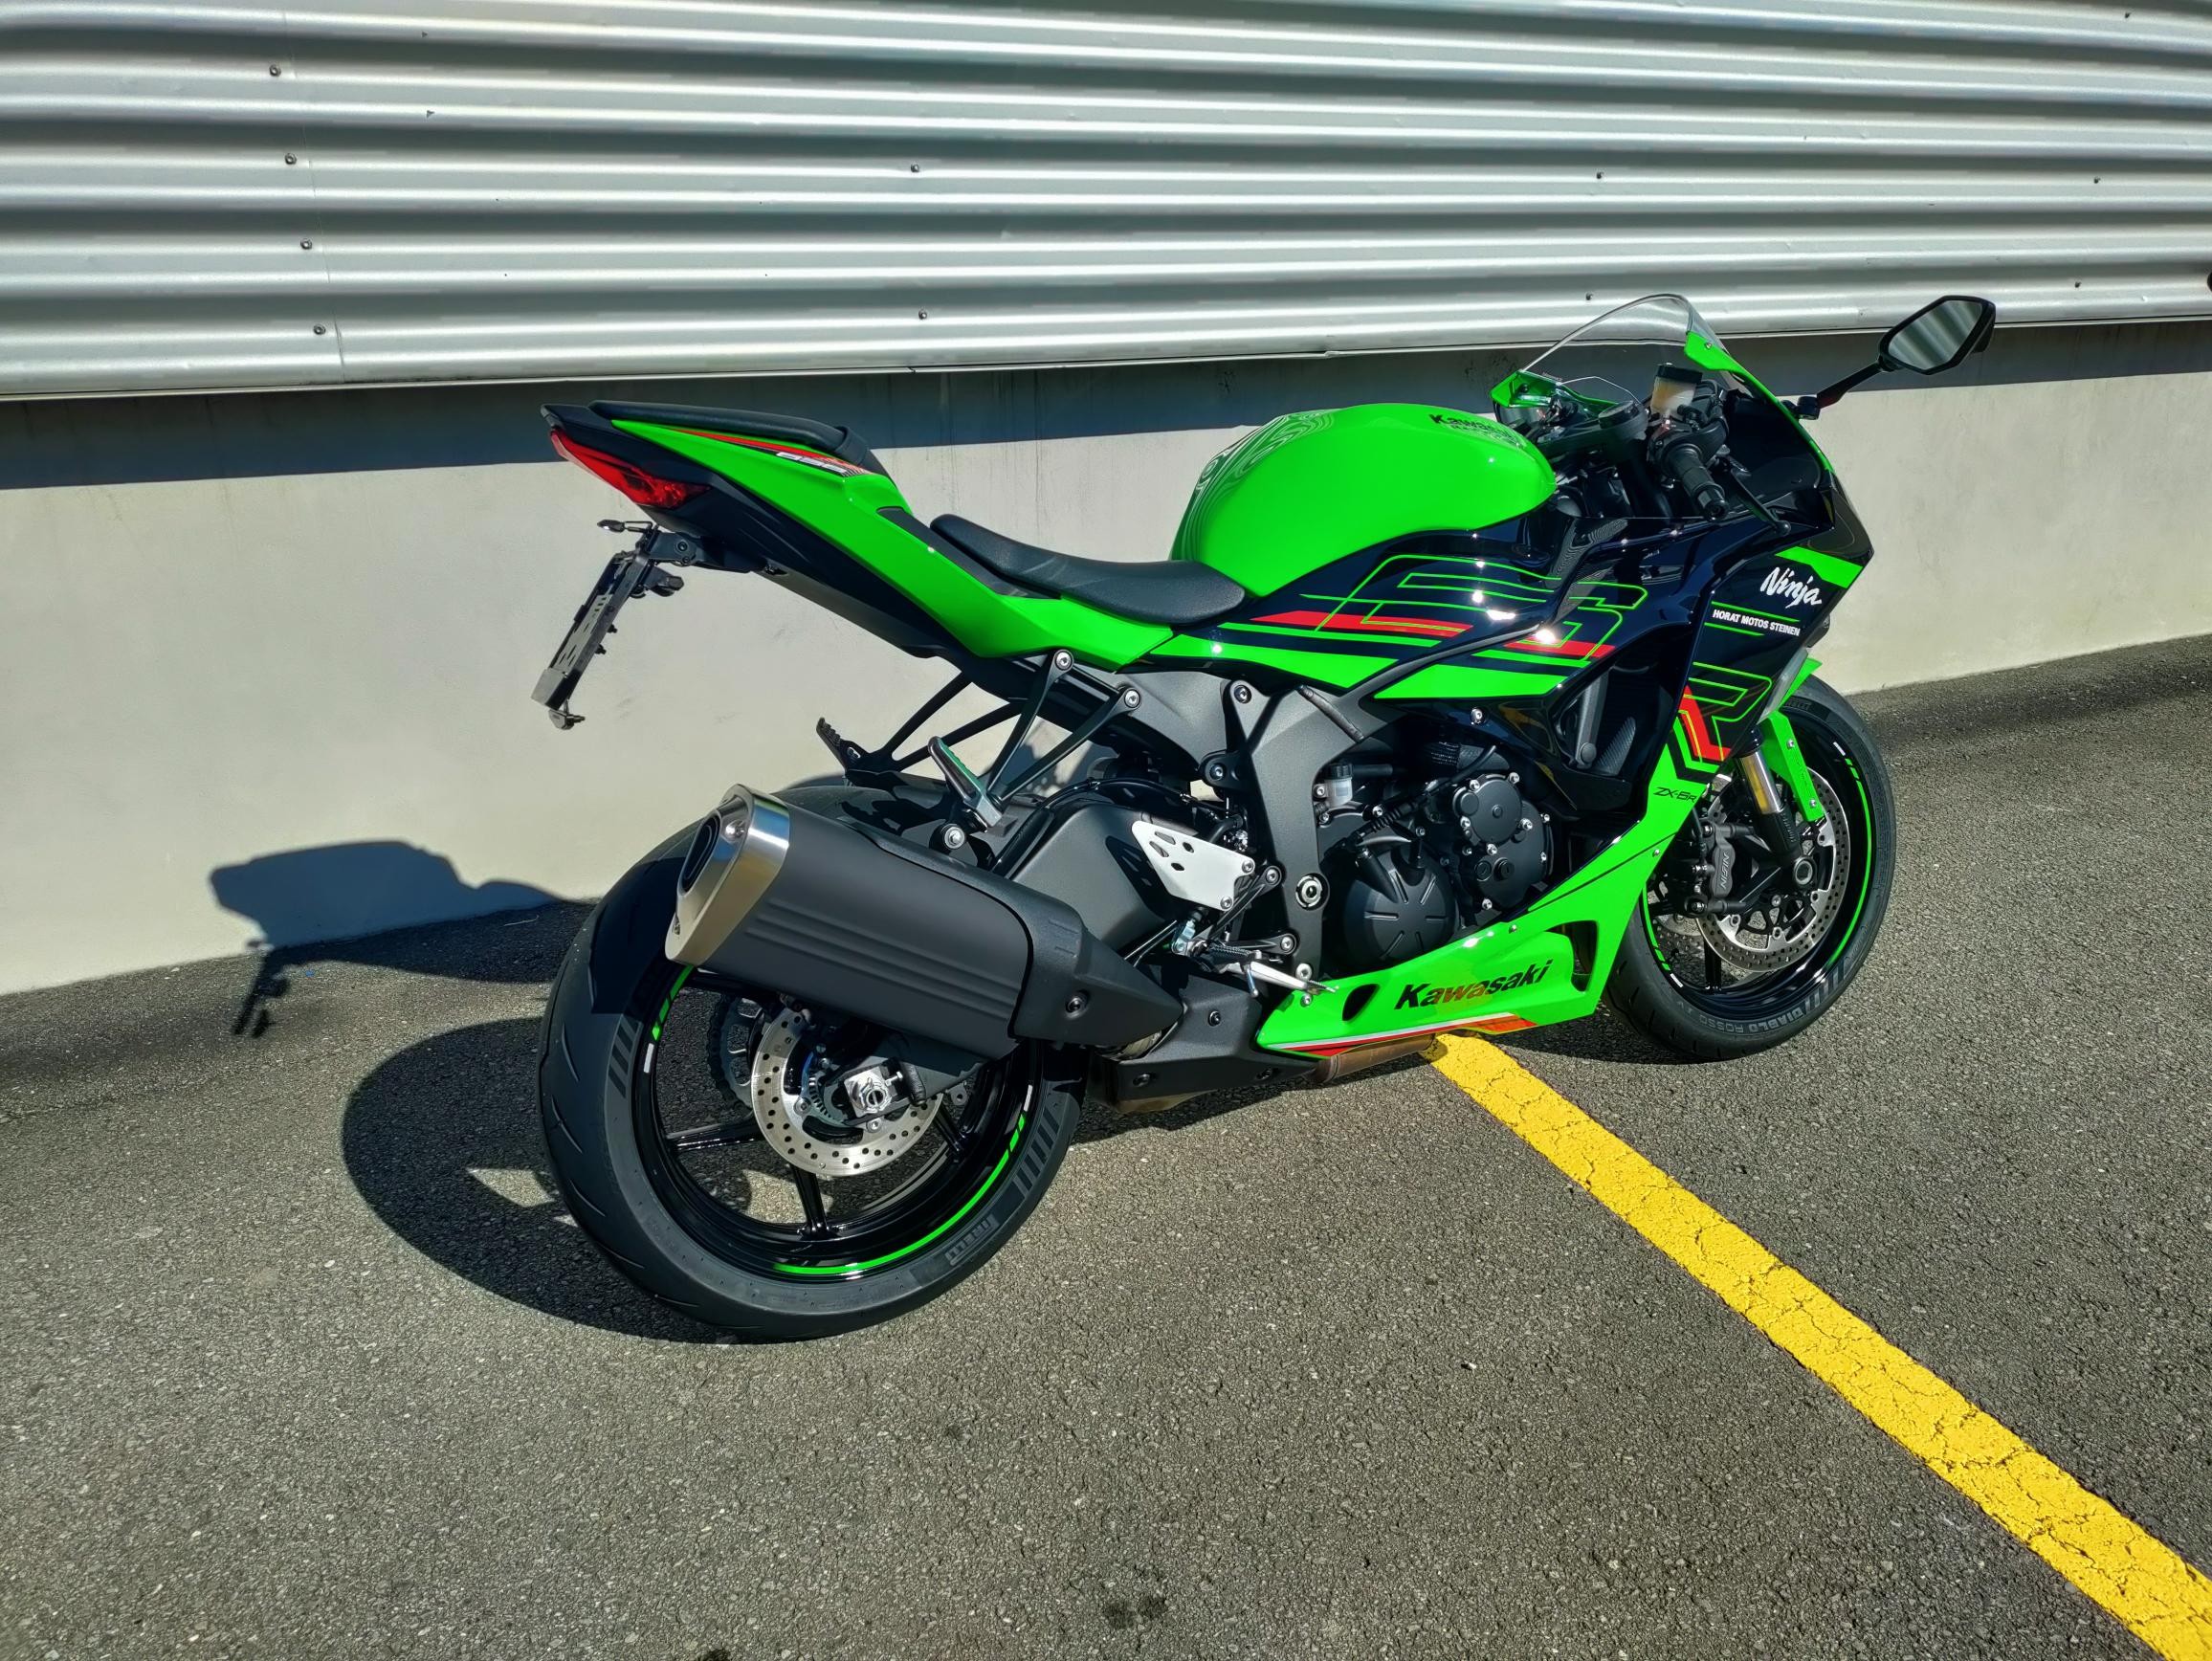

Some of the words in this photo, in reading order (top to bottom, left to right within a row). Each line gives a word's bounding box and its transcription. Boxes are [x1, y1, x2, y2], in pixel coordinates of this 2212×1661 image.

[1759, 566, 1823, 609] Ninja
[1713, 609, 1740, 623] HORAT
[1740, 615, 1769, 629] MOTOS
[1769, 622, 1802, 636] STEINEN
[1653, 786, 1698, 803] ZX-6R
[1394, 959, 1554, 1009] Kawasaki
[1699, 1014, 1744, 1033] ROSSO
[1748, 1006, 1804, 1032] DIABLO
[944, 1213, 1000, 1267] PIRELLI
